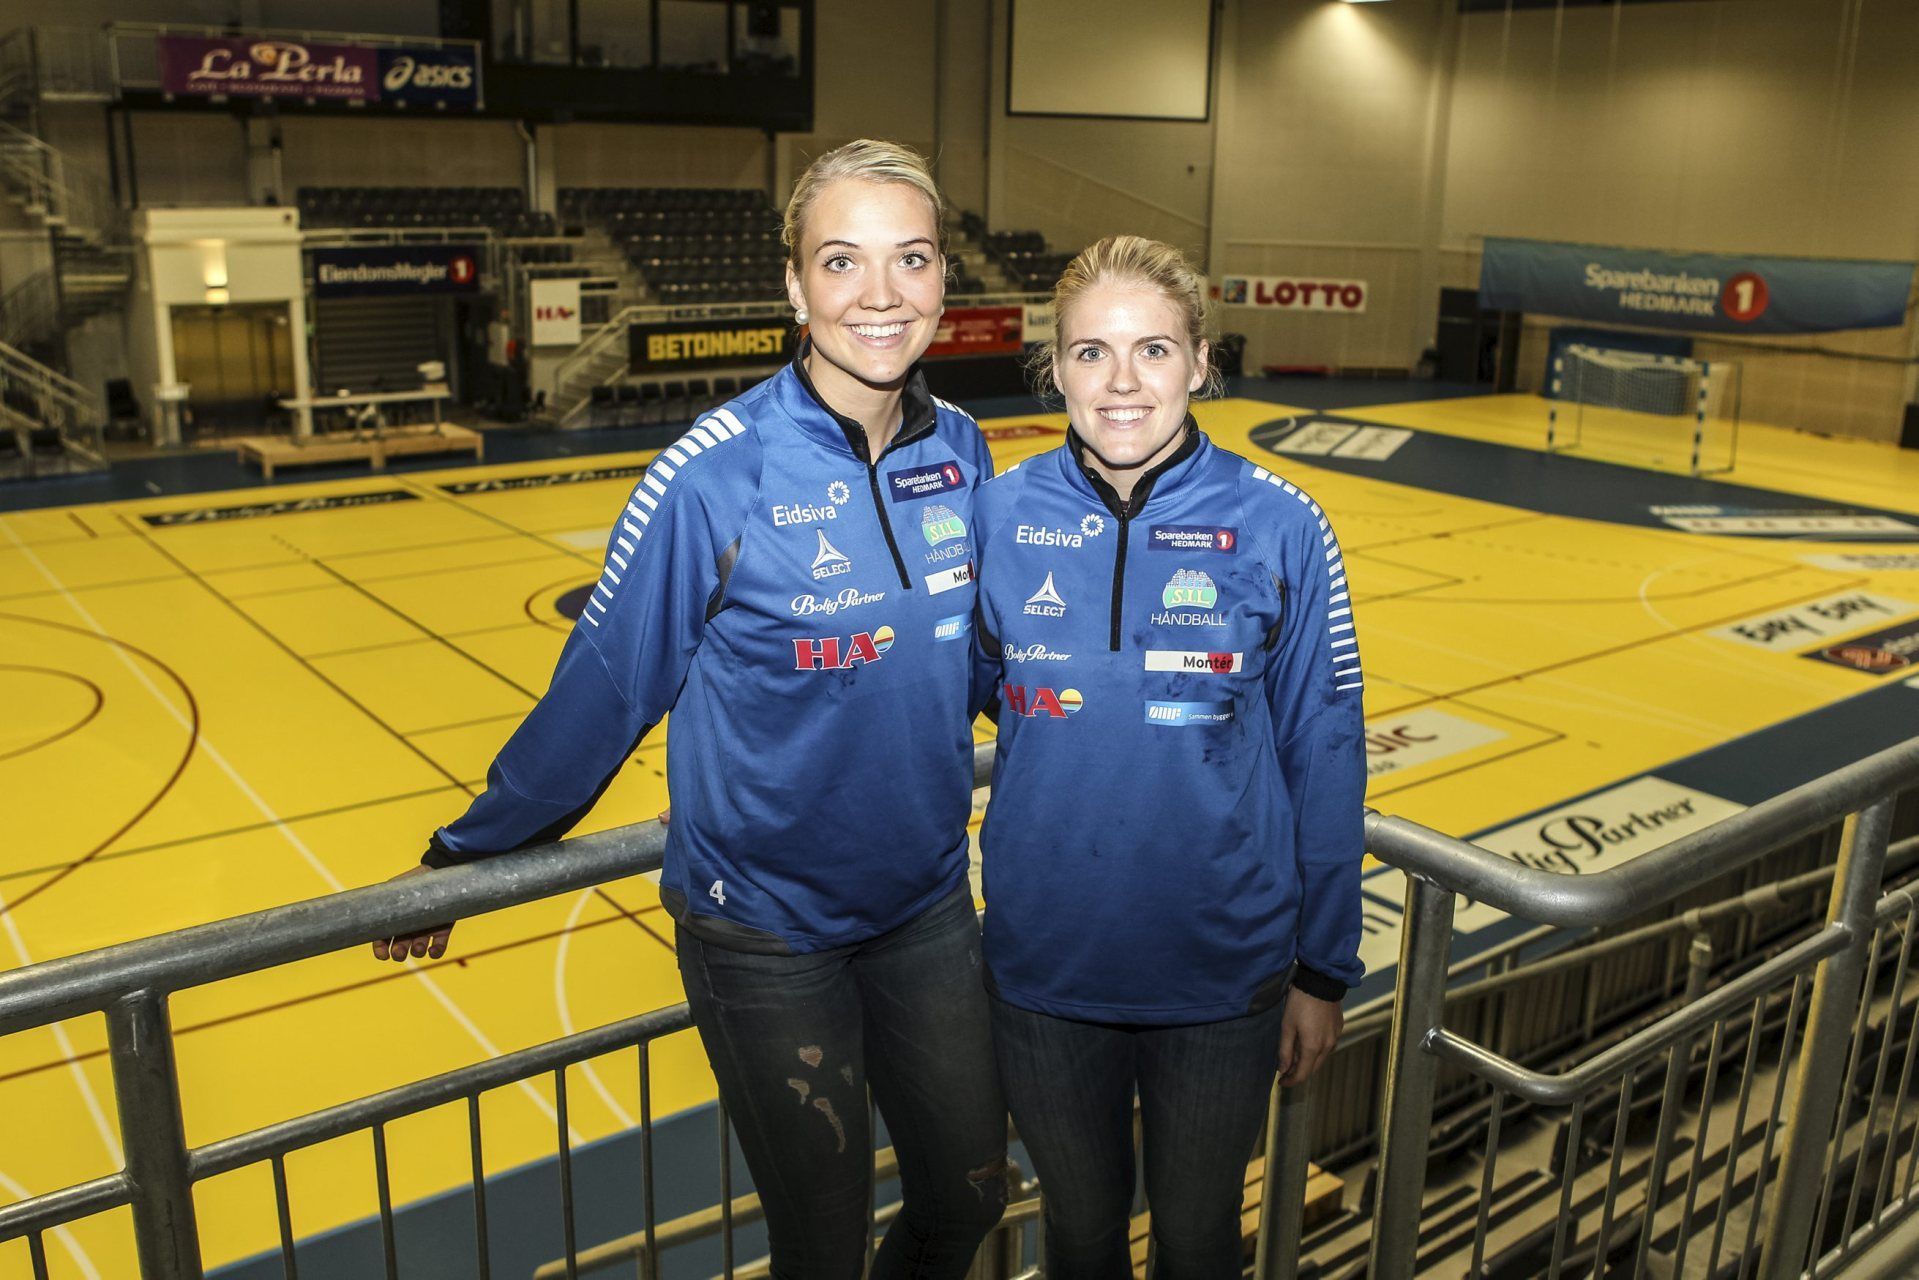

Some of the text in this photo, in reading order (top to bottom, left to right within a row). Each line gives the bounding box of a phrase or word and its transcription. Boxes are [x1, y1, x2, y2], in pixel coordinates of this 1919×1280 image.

[189, 41, 363, 83] La Perla
[413, 63, 471, 88] asics
[455, 259, 467, 279] 1
[1584, 263, 1720, 297] Sparebanken
[1255, 281, 1363, 308] LOTTO
[1619, 291, 1716, 316] HEDMARK
[1735, 280, 1754, 313] 1
[647, 328, 786, 361] BETONMAST
[895, 472, 942, 489] Sparebanken
[945, 468, 956, 483] 1
[912, 480, 944, 493] HEDMARK
[772, 503, 837, 527] Eidsiva
[1016, 525, 1083, 548] Eidsiva
[1155, 530, 1213, 541] Sparebanken
[1171, 540, 1212, 548] HEDMARK
[1219, 534, 1228, 547] 1
[812, 561, 851, 580] SELECT
[1023, 604, 1066, 618] SELECT
[1150, 610, 1227, 626] HÅNDBALL
[792, 631, 882, 671] HA
[1183, 655, 1232, 669] Montér
[1004, 683, 1068, 718] HA
[1188, 712, 1212, 720] Sammen
[709, 879, 727, 906] 4
